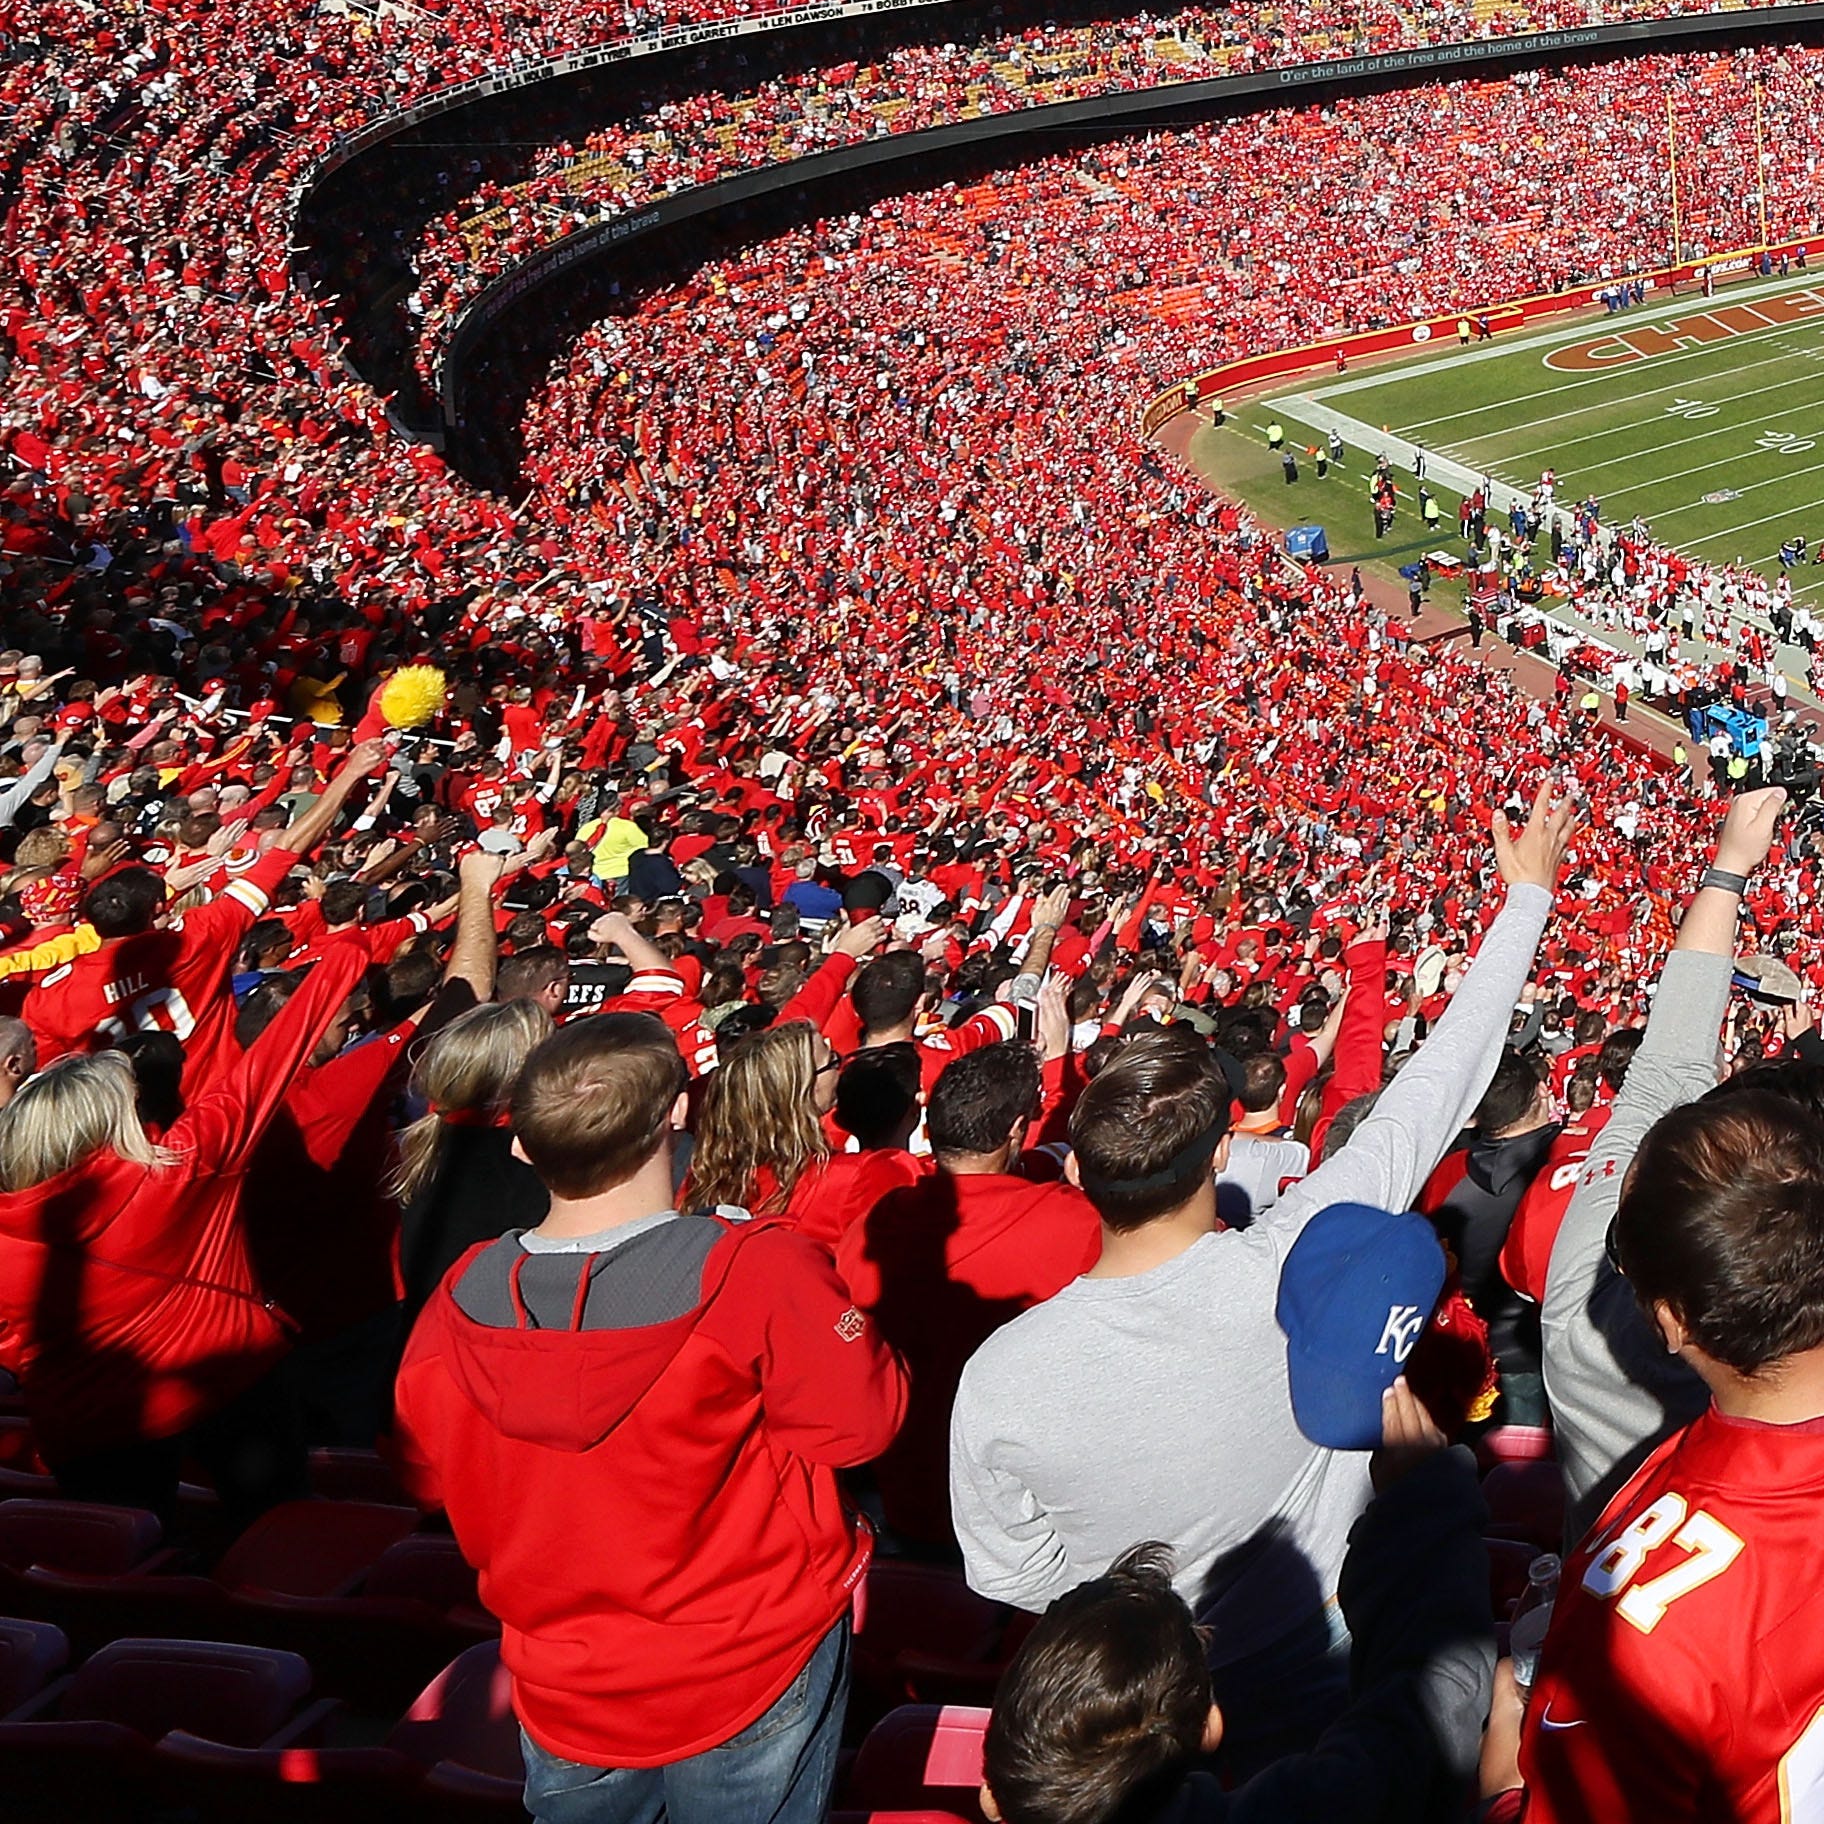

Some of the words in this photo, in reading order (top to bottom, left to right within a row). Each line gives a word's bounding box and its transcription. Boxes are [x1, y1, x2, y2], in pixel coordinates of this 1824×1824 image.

[662, 35, 688, 48] MIKE
[691, 25, 740, 43] GARRETT
[771, 15, 793, 27] LEN
[795, 7, 844, 23] DAWSON
[1280, 69, 1308, 84] O'er
[1311, 65, 1334, 80] the
[1336, 61, 1364, 75] land
[1367, 58, 1380, 70] of
[1383, 56, 1404, 68] the
[1407, 52, 1434, 66] free
[1437, 47, 1460, 60] and
[1463, 45, 1484, 58] the
[1487, 39, 1522, 54] home
[1524, 37, 1537, 49] of
[1540, 34, 1560, 47] the
[1563, 29, 1598, 44] brave
[103, 973, 150, 1004] HILL
[1375, 1305, 1423, 1364] KC
[1581, 1491, 1747, 1635] 87
